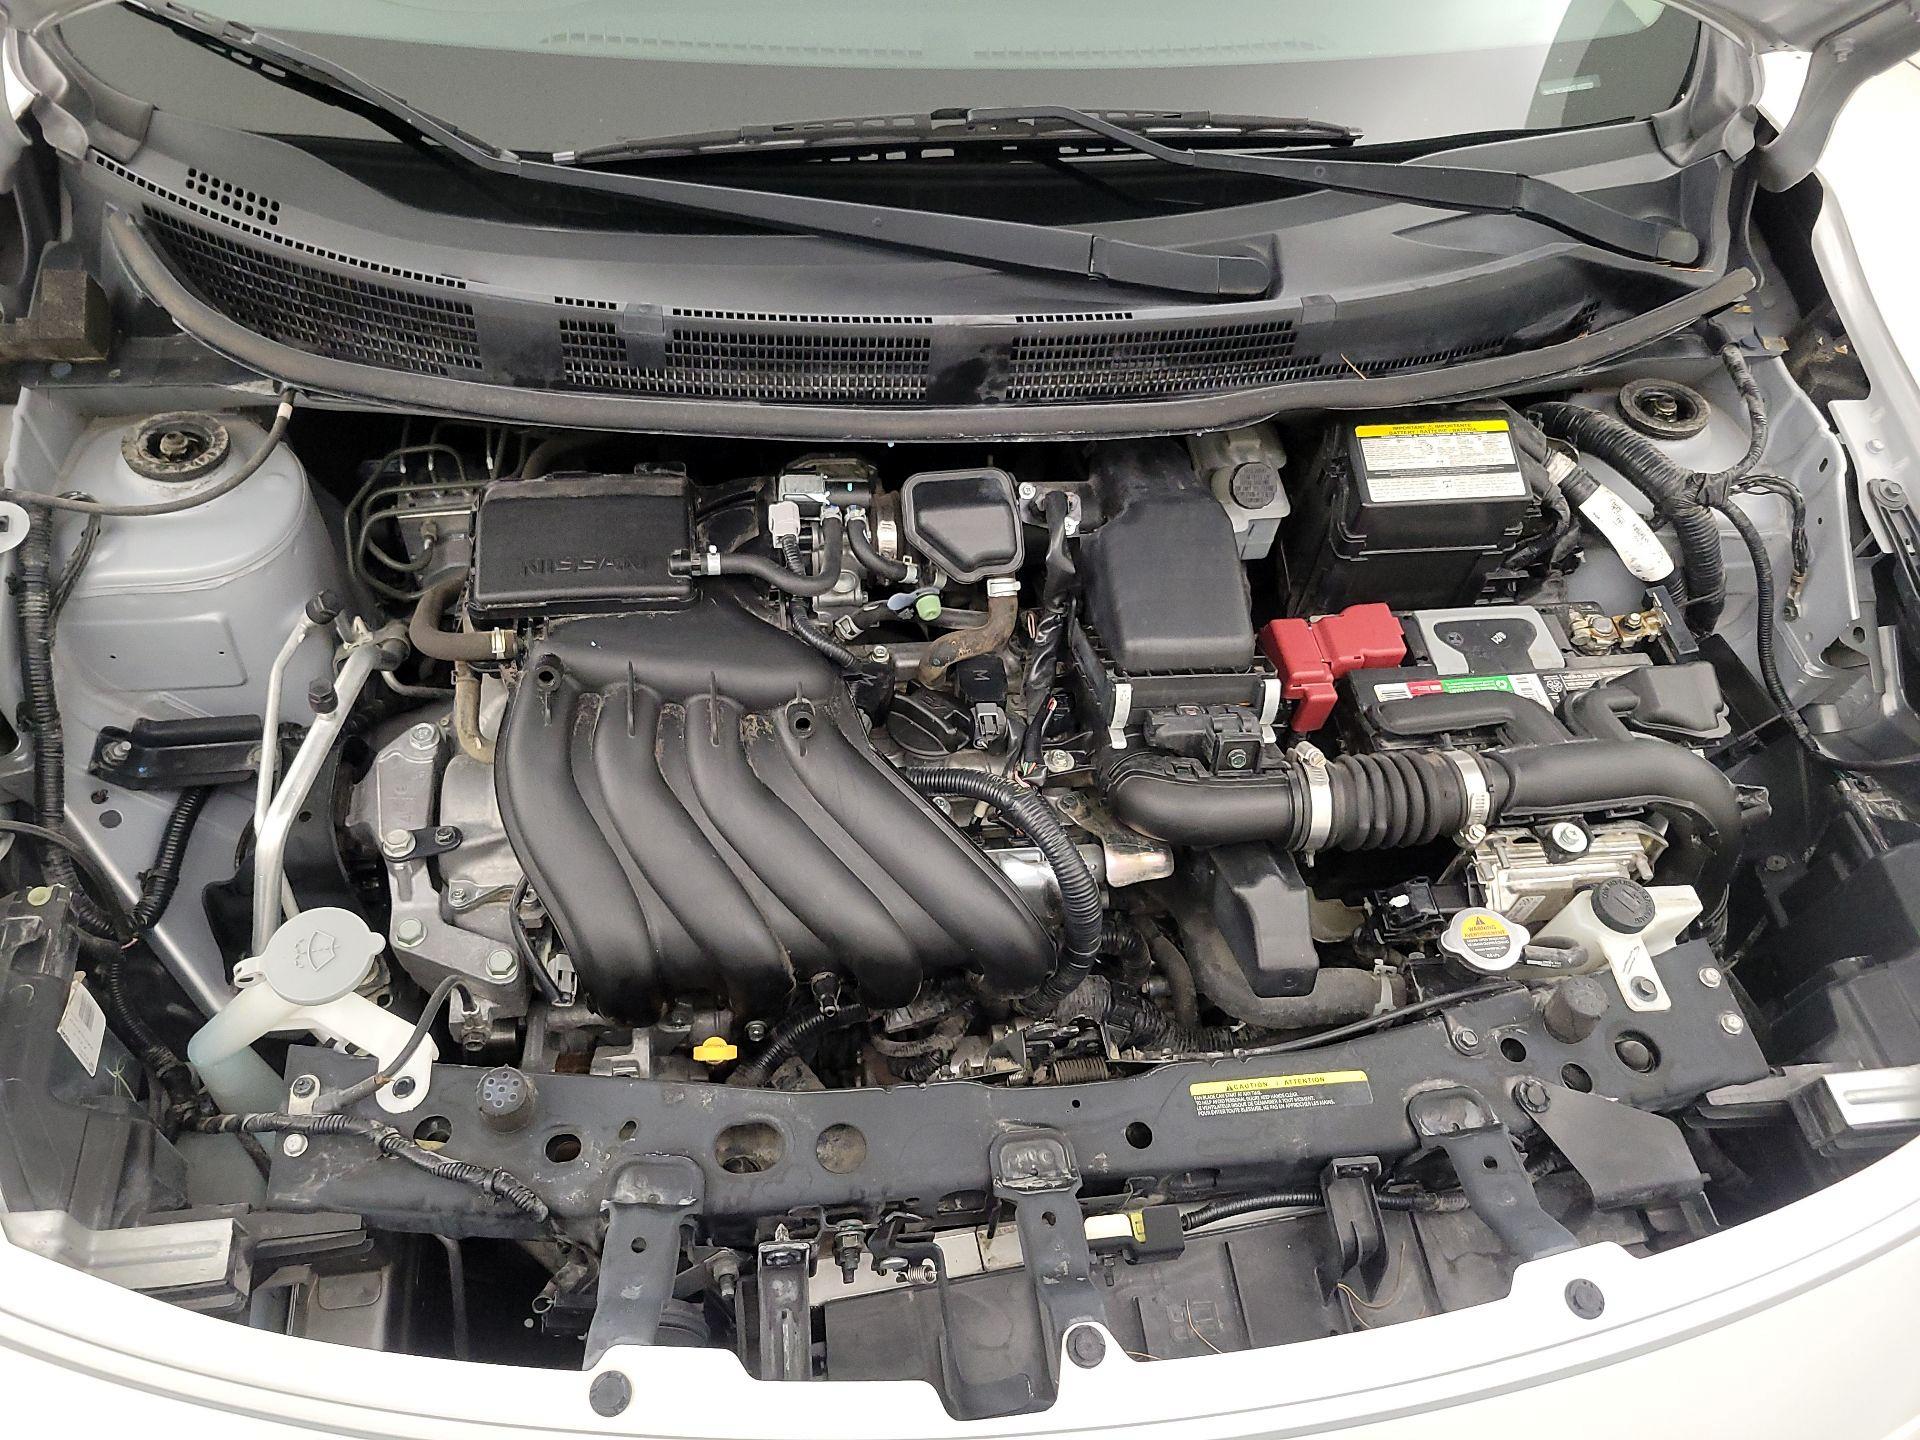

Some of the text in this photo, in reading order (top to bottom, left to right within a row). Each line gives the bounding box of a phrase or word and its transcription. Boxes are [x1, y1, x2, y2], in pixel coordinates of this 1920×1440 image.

[523, 557, 639, 577] NISSAN
[1234, 1082, 1268, 1090] CAUTION
[1284, 1077, 1325, 1085] ATTENTION
